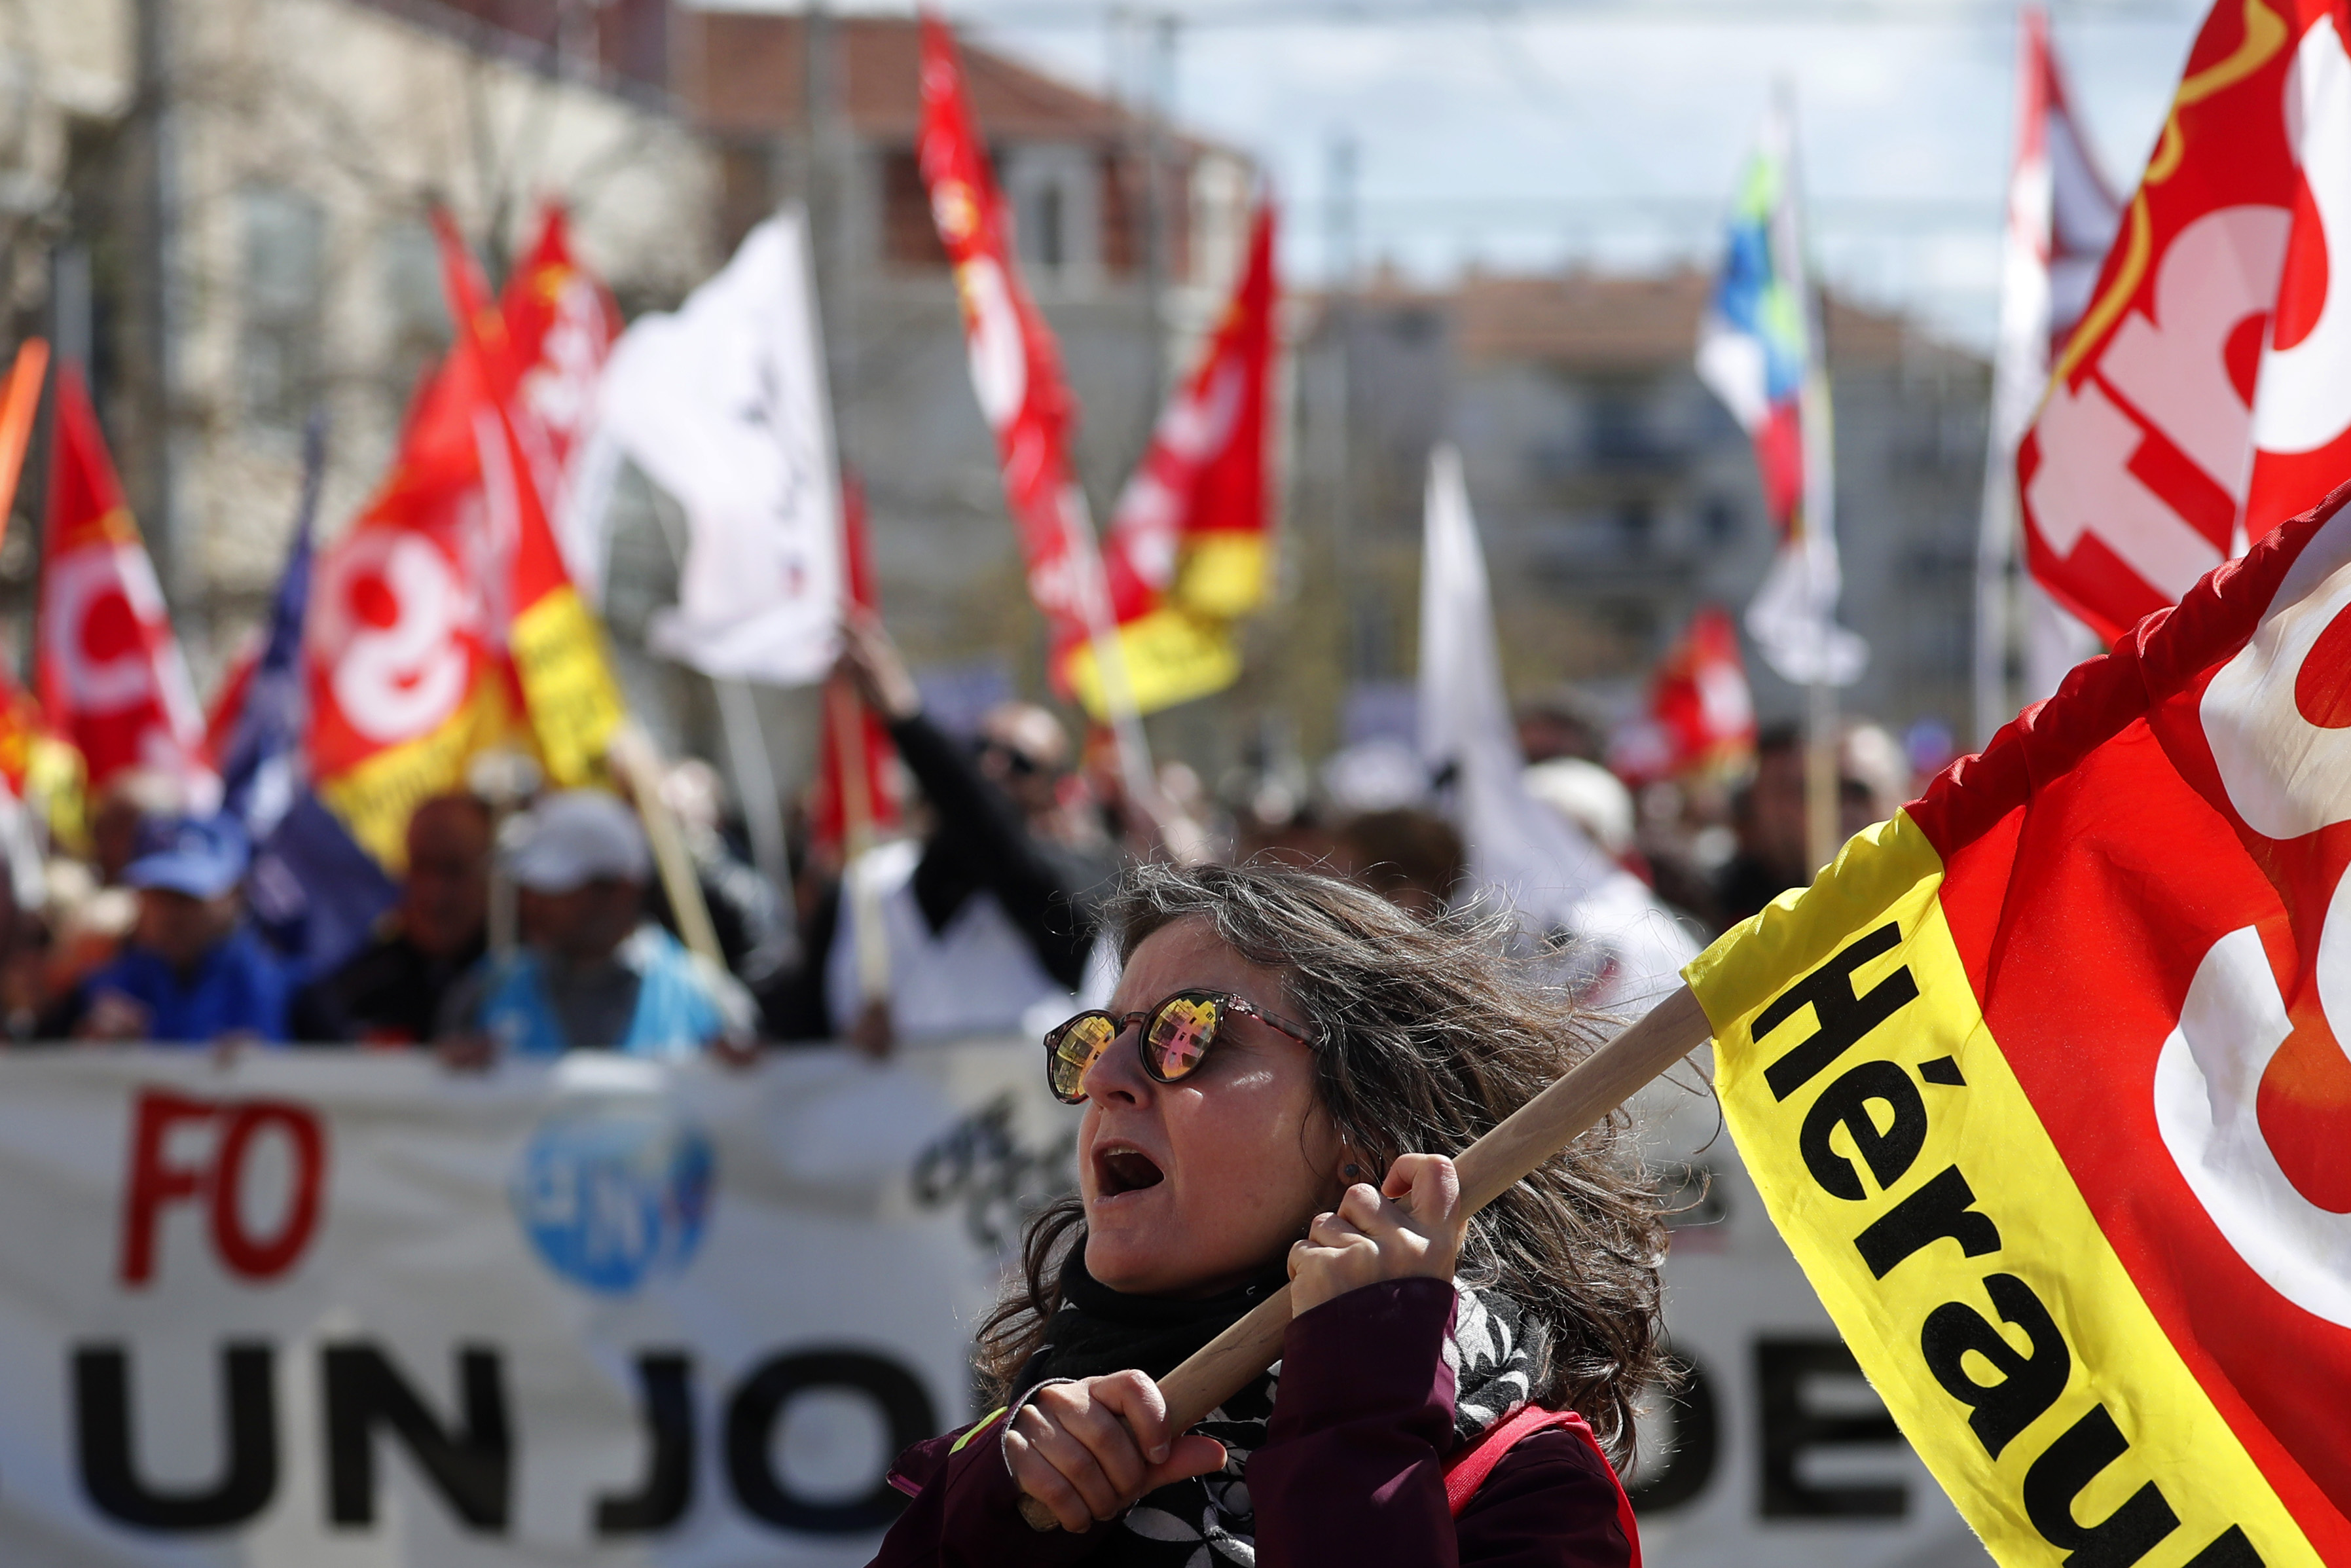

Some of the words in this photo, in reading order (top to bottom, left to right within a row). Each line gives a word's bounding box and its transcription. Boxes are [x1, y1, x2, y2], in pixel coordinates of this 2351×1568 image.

[117, 1085, 326, 1287] FO
[69, 1338, 515, 1531] UN
[593, 1342, 943, 1533] JO
